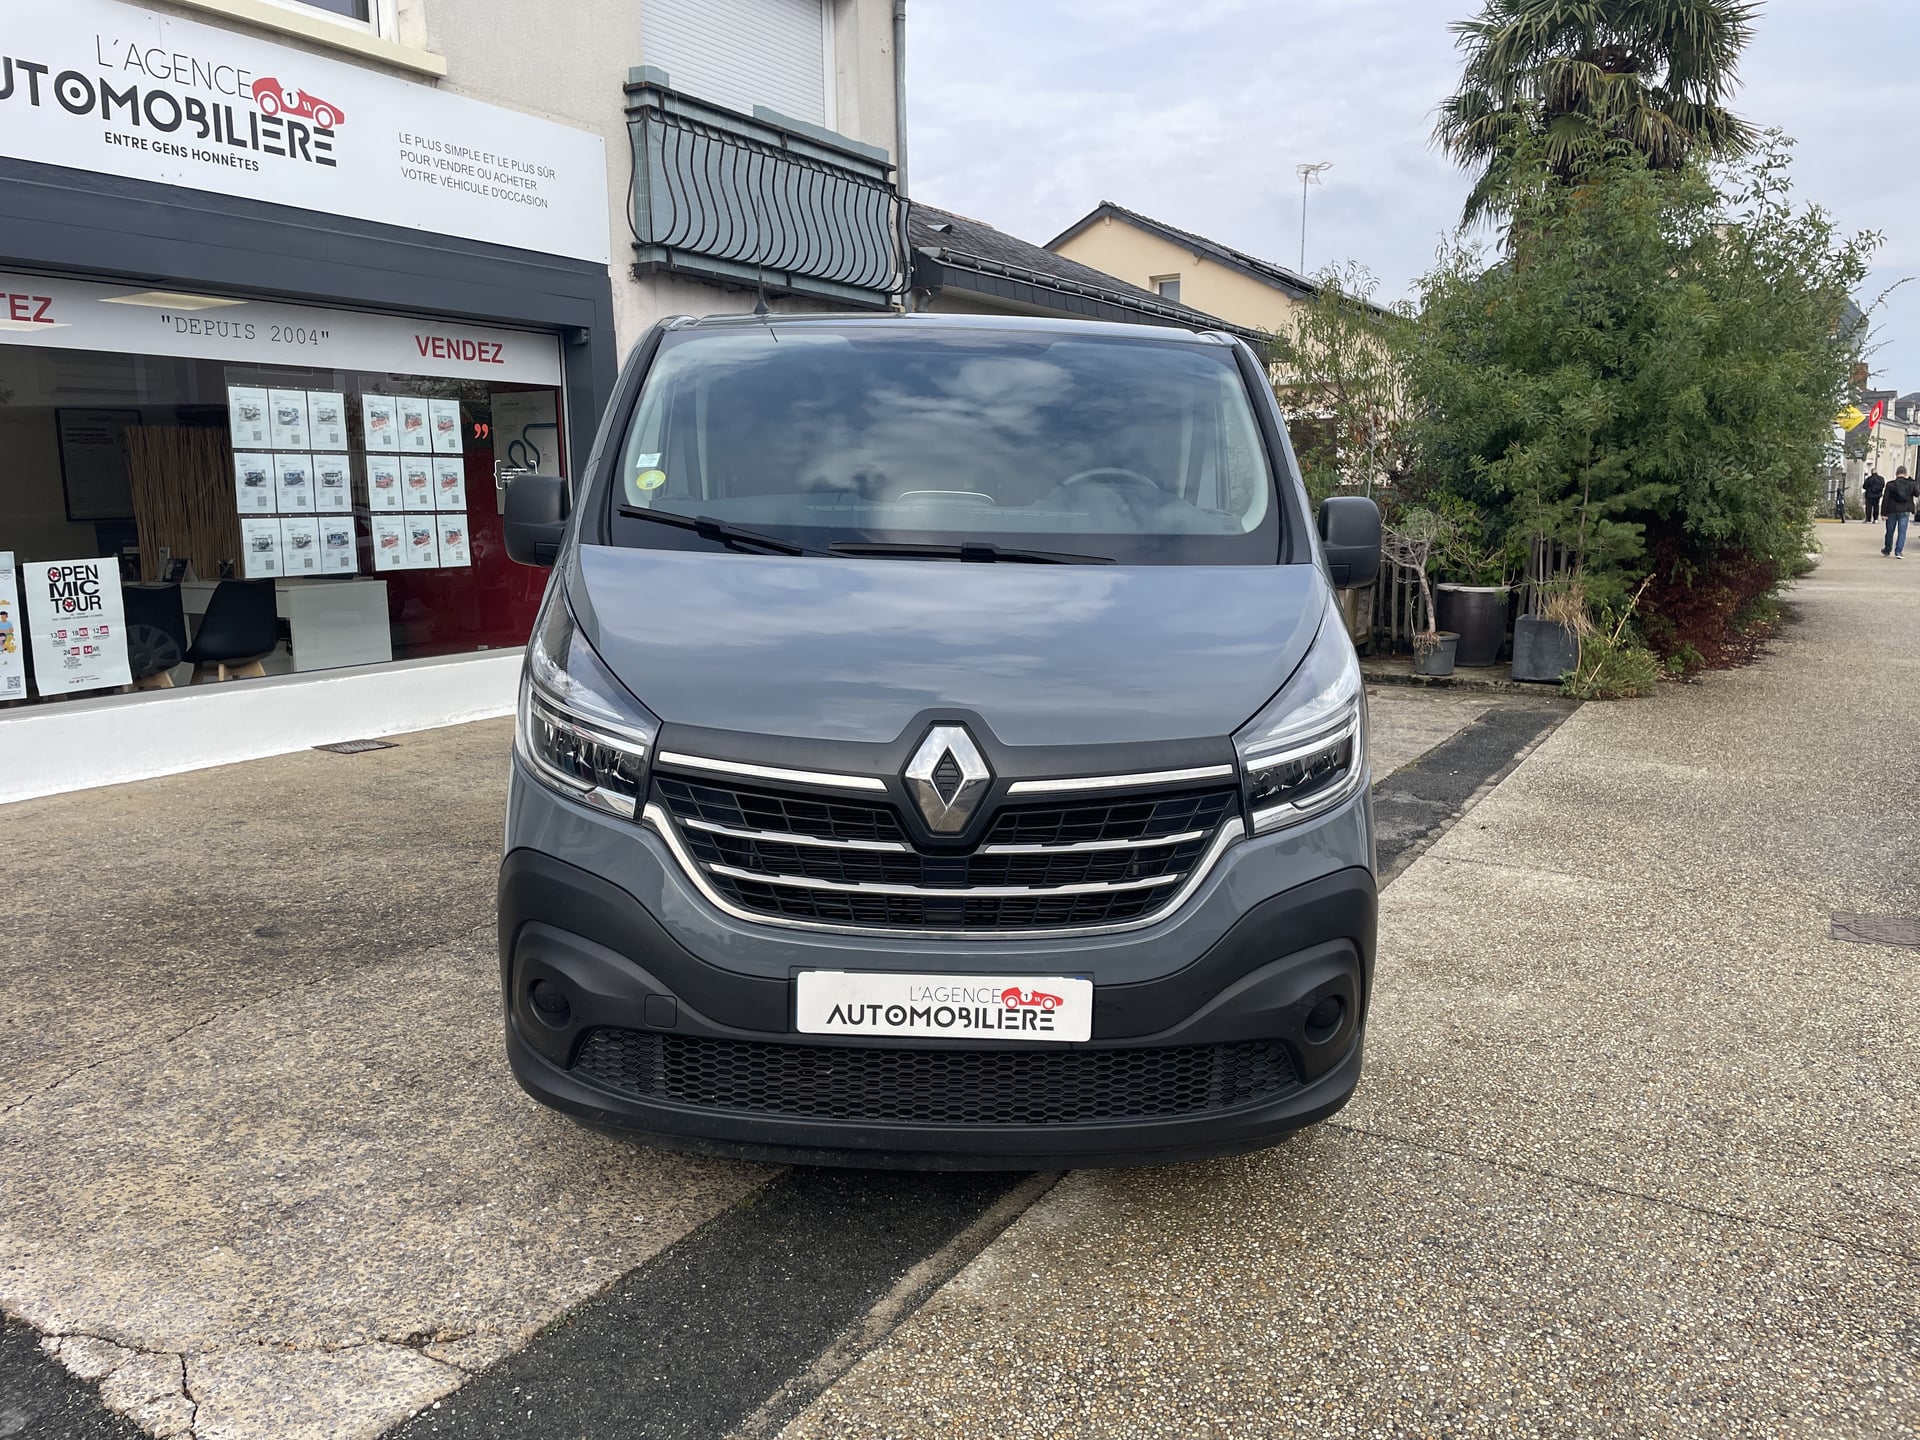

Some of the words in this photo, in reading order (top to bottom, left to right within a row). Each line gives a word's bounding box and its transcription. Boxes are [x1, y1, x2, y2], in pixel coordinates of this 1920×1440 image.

[96, 34, 253, 100] L'AGENCE
[286, 92, 294, 105] 1
[104, 131, 149, 151] ENTRE
[151, 141, 188, 158] GENS
[191, 148, 259, 172] HONNÊTES
[398, 132, 412, 145] LE
[414, 136, 442, 152] PLUS
[444, 143, 481, 162] SIMPLE
[483, 152, 496, 165] ET
[497, 156, 509, 169] LE
[511, 160, 535, 175] PLUS
[537, 165, 556, 180] SÛR
[400, 149, 431, 167] POUR
[433, 157, 475, 177] VENDRE
[477, 167, 492, 181] OU
[493, 172, 538, 190] ACHETER
[401, 167, 437, 185] VOTRE
[439, 175, 489, 196] VÉHICULE
[491, 187, 548, 208] D'OCCASION
[0, 293, 55, 323] EZ
[415, 335, 504, 364] VENDEZ
[47, 564, 99, 583] OPEN
[48, 580, 100, 598] MIC
[50, 595, 102, 614] TOUR
[910, 986, 1002, 1004] L'AGENCE
[1024, 993, 1029, 1001] 1
